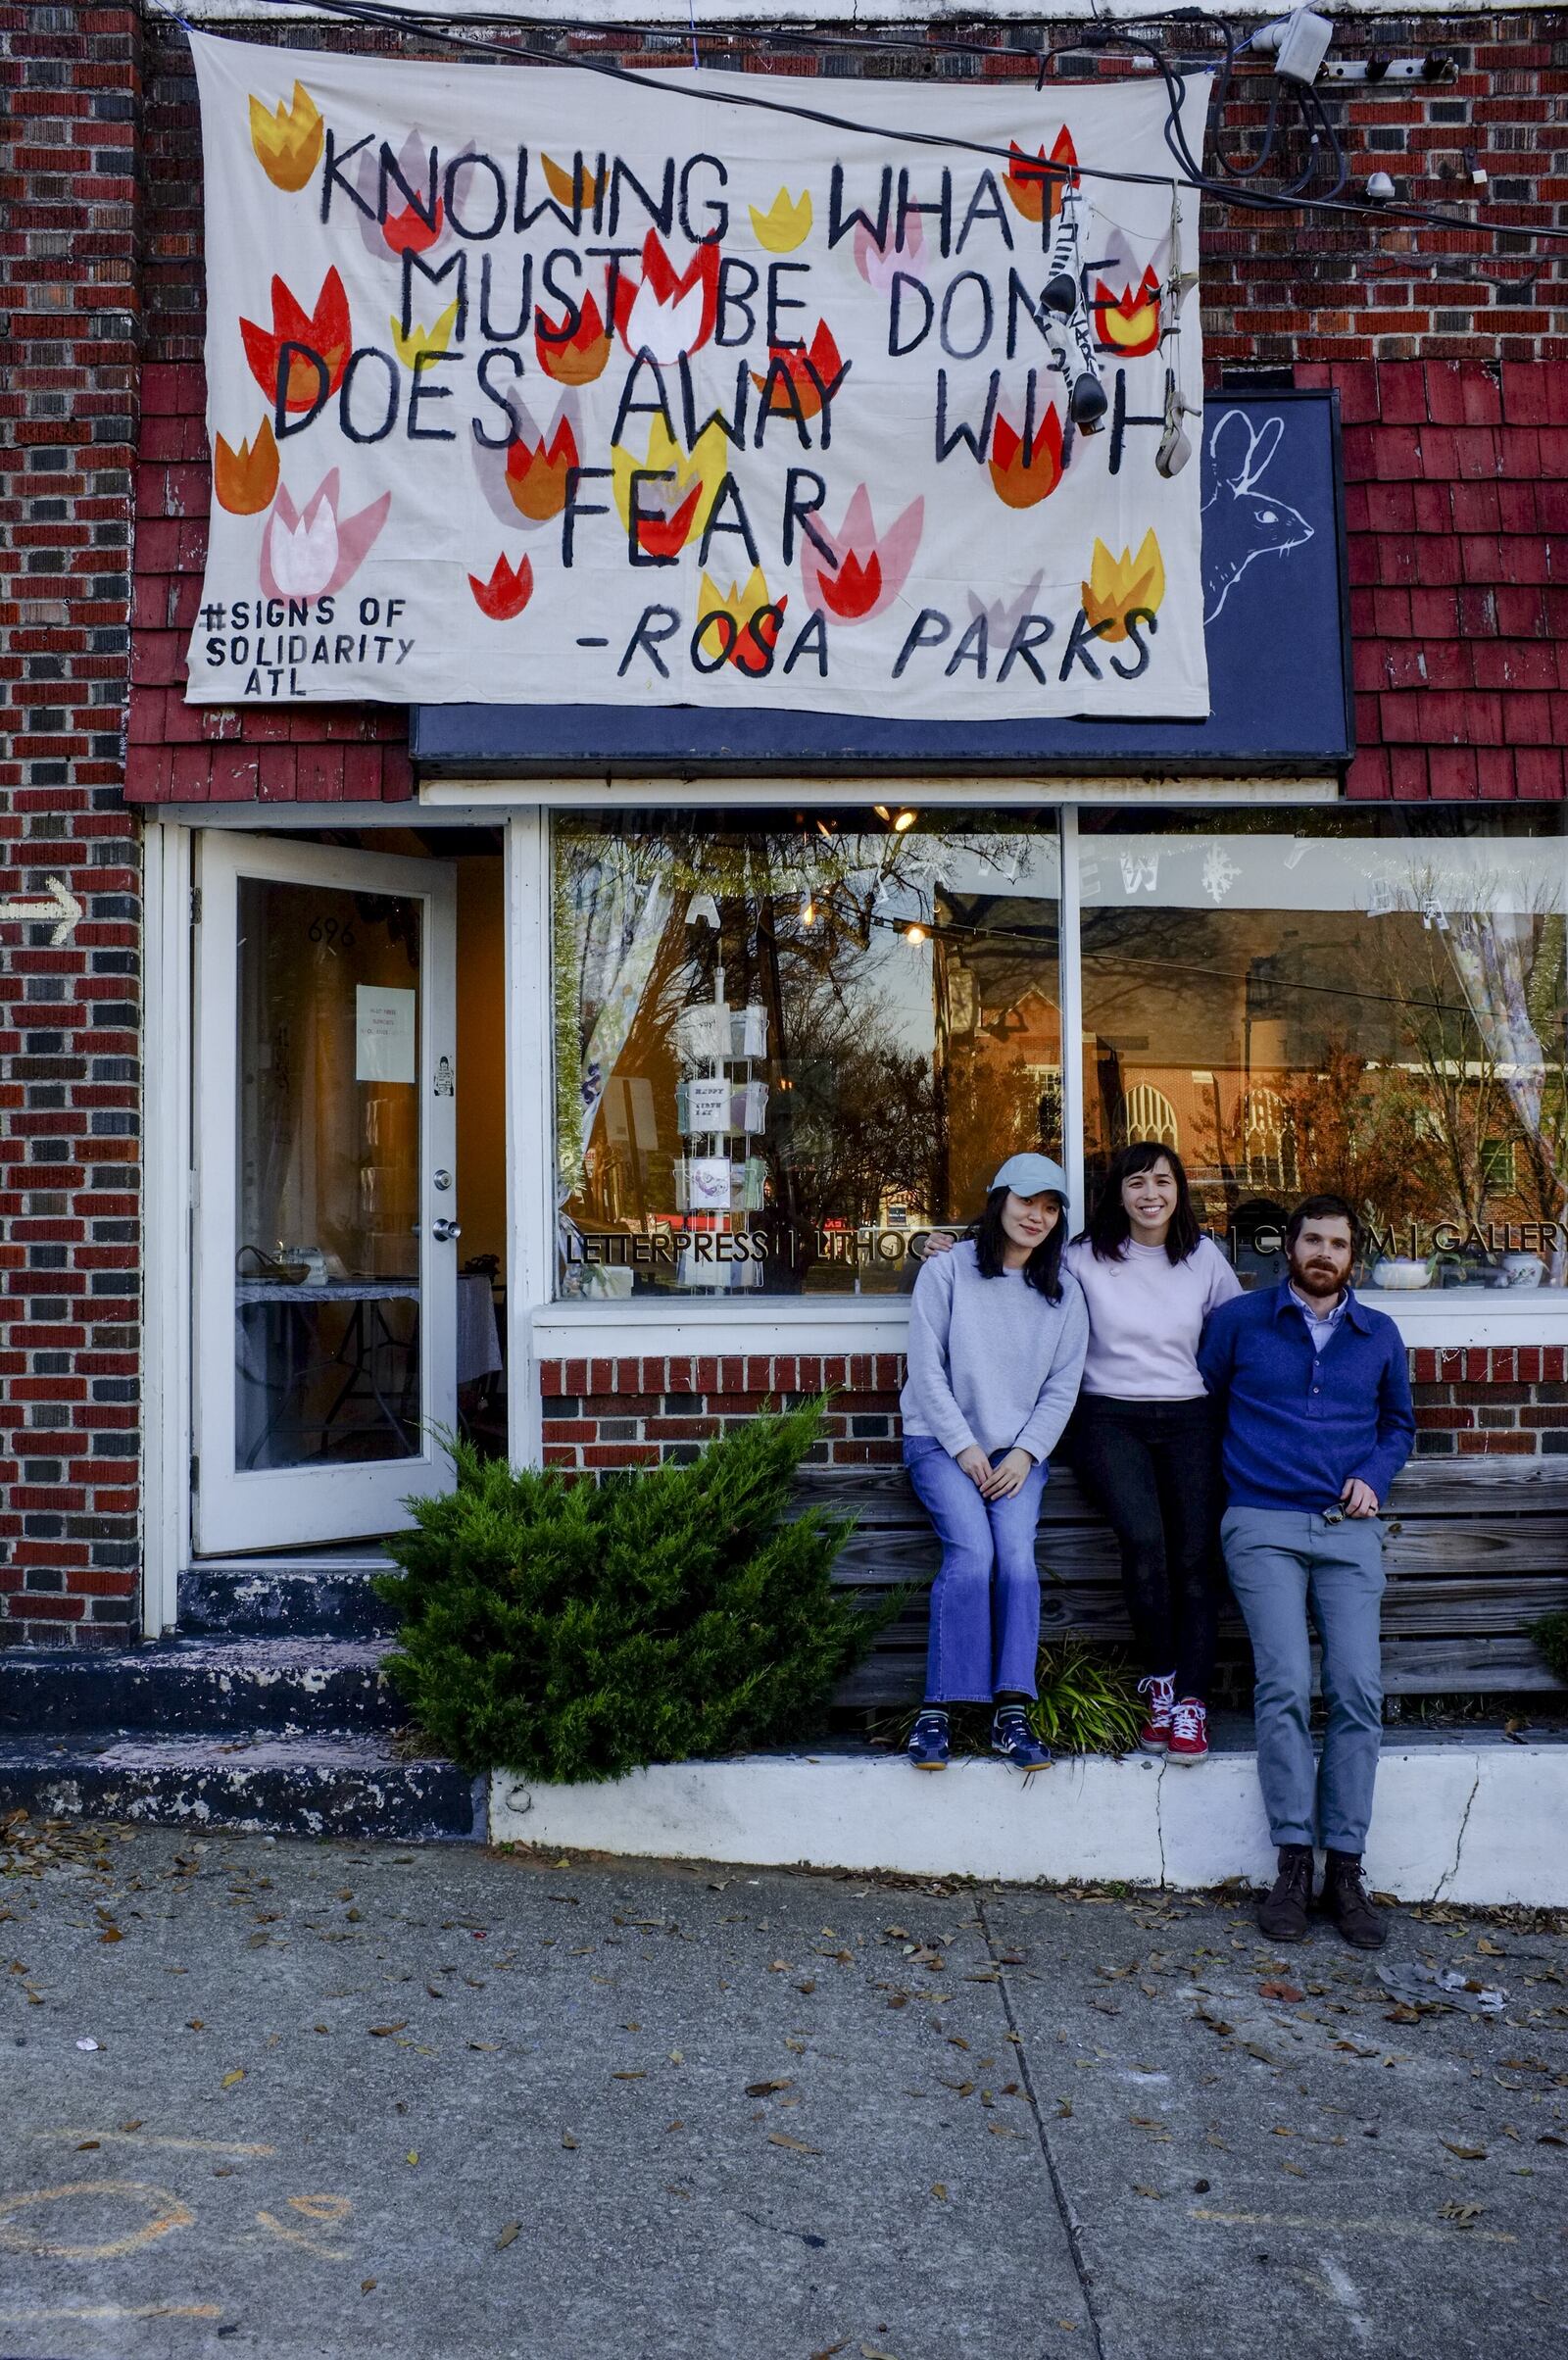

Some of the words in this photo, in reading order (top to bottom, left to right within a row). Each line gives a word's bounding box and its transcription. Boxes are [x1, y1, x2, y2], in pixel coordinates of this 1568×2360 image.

[319, 128, 729, 244] KNOWING
[828, 159, 1081, 259] WHAT
[401, 246, 642, 343] MUST
[715, 257, 811, 350] BE
[889, 259, 1128, 360] DONE
[275, 341, 525, 450] DOES
[611, 345, 853, 452] AWAY
[936, 368, 1176, 474] WITH
[562, 467, 838, 570] FEAR
[199, 595, 335, 630] #SIGNS
[359, 596, 408, 628] OF
[207, 633, 416, 667] SOLIDARITY
[891, 608, 1158, 685] PARKS
[244, 667, 307, 697] ATL
[308, 916, 357, 948] 696
[566, 1231, 768, 1264] LETTERPRESS
